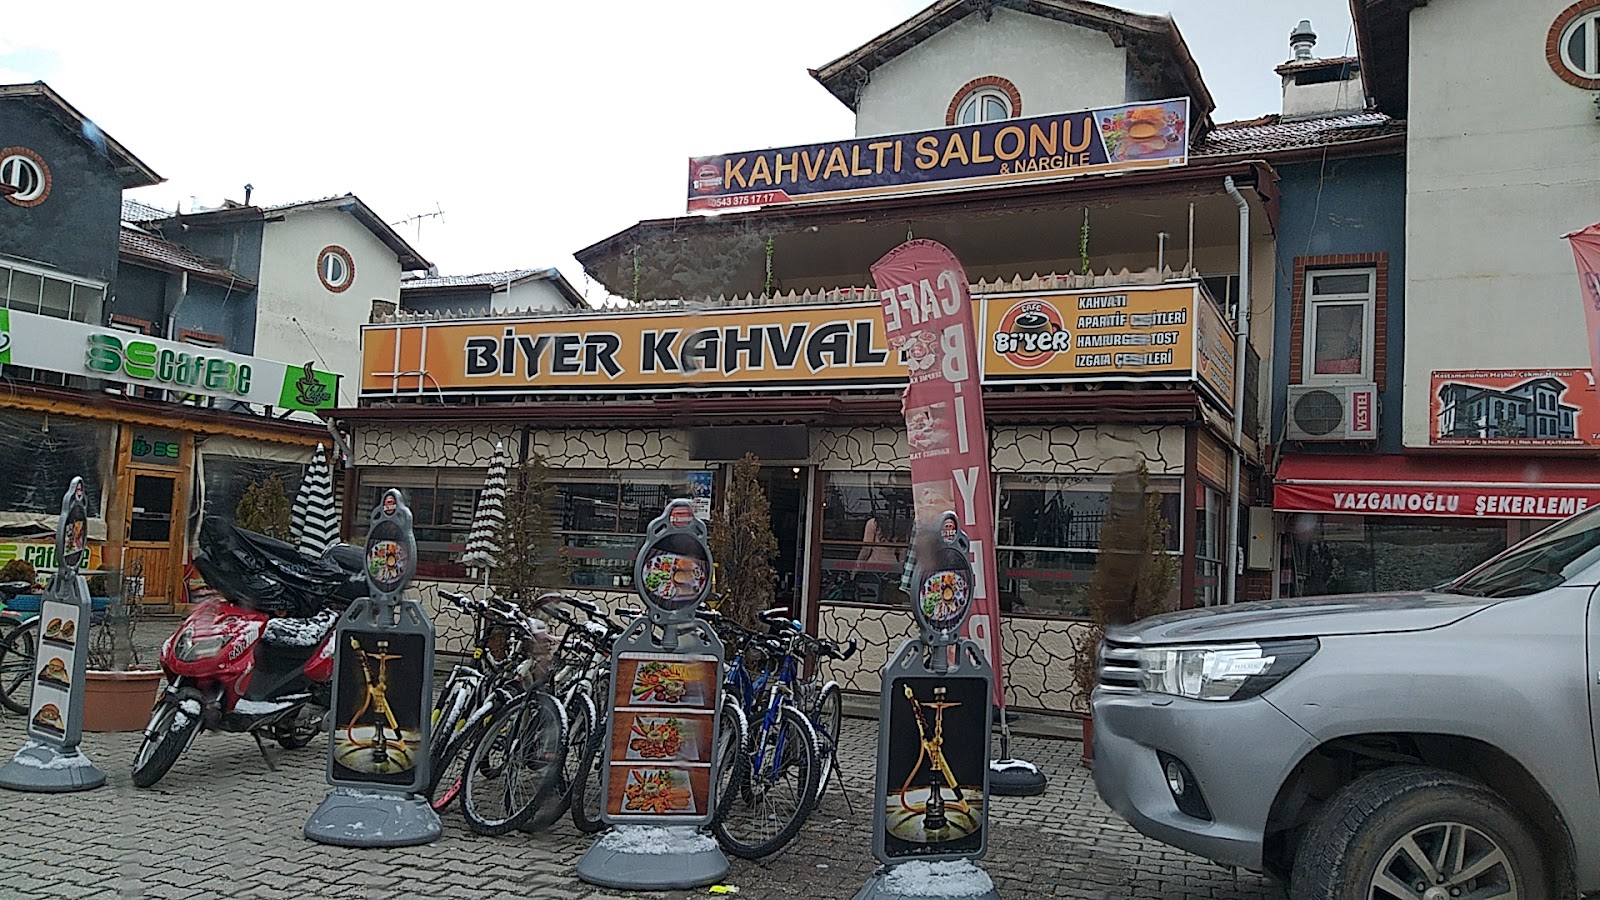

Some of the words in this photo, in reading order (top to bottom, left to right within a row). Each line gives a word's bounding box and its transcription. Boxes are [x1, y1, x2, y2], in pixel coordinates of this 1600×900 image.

[724, 140, 902, 189] KAHVALTI
[915, 117, 1092, 170] SALONU
[1000, 163, 1010, 174] &
[1015, 152, 1091, 173] NARGİLE
[733, 196, 749, 205] 375
[751, 194, 761, 203] 17
[763, 193, 774, 202] 17
[465, 327, 624, 380] BİYER
[641, 319, 907, 377] KAHVAL
[1150, 331, 1179, 345] TOST
[1357, 393, 1367, 430] VESTEL
[1333, 492, 1459, 511] YAZGANOĞLU
[1475, 496, 1588, 516] ŞEKERLEME
